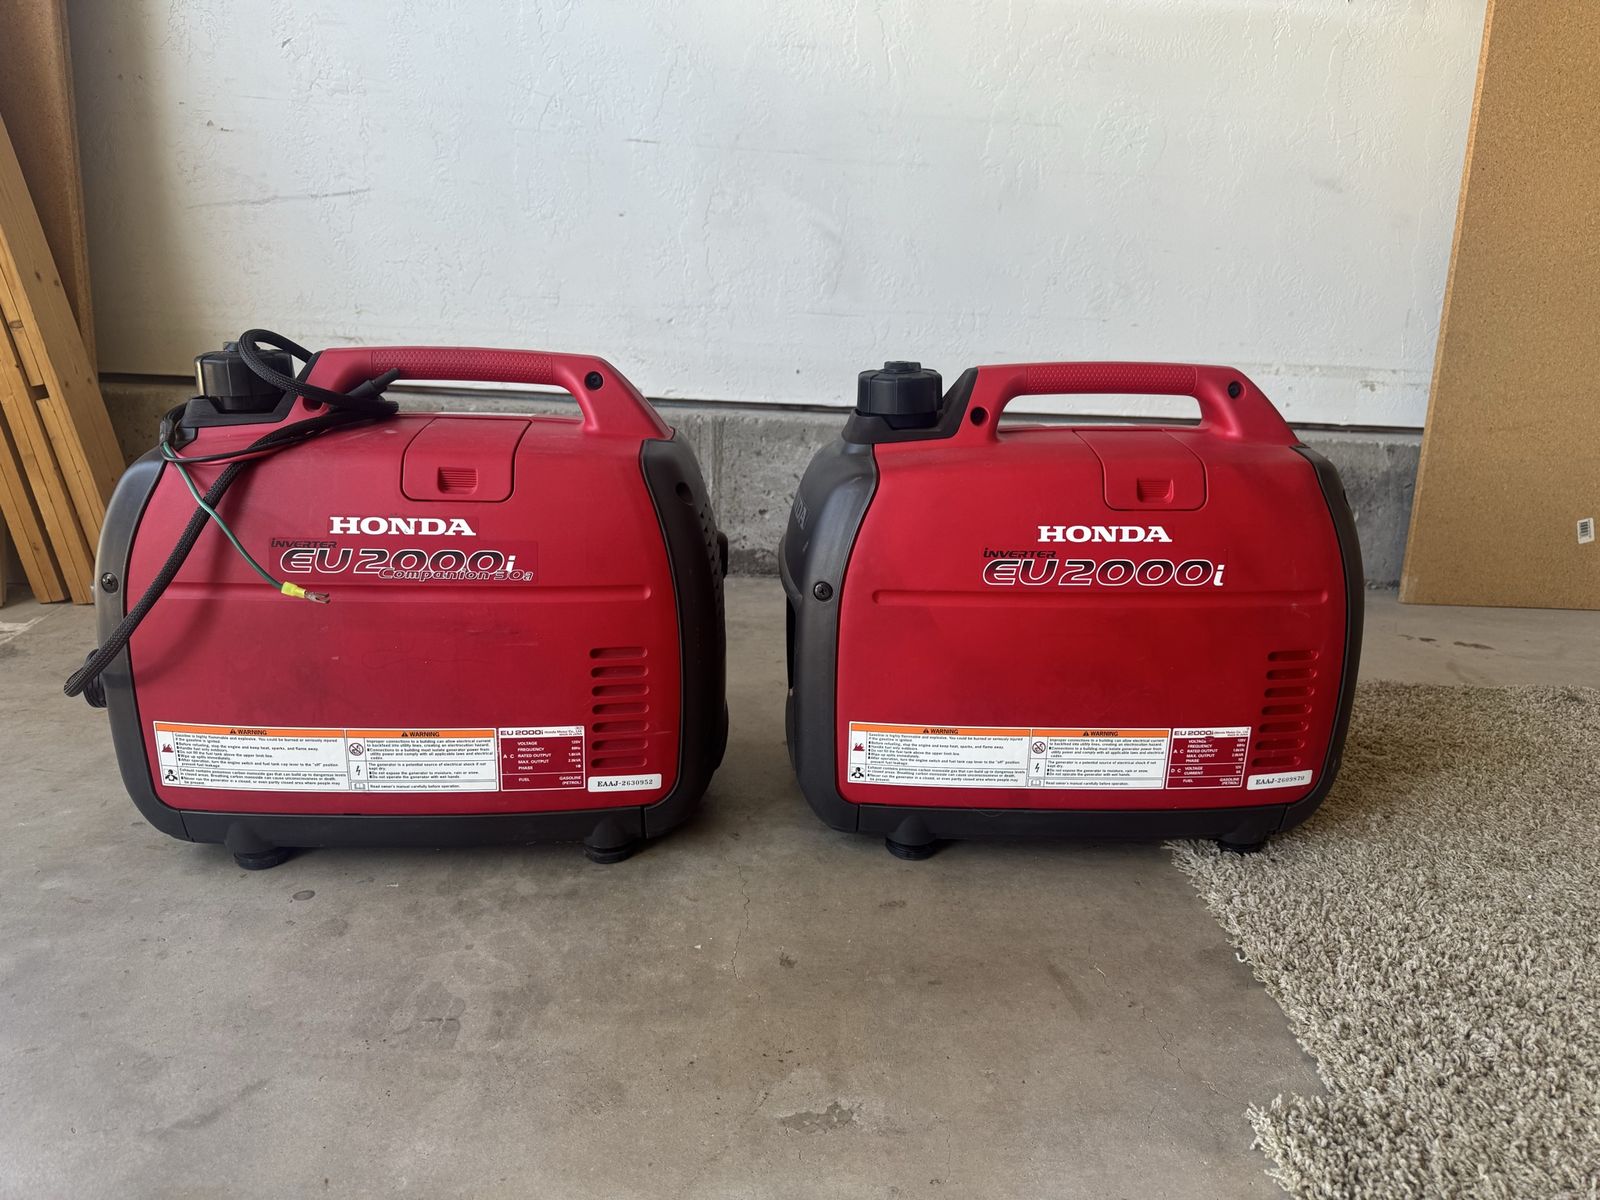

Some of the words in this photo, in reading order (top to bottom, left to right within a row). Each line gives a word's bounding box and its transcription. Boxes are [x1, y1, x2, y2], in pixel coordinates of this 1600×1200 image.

[330, 516, 476, 536] HONDA
[1038, 526, 1172, 542] HONDA
[378, 568, 490, 581] Companion
